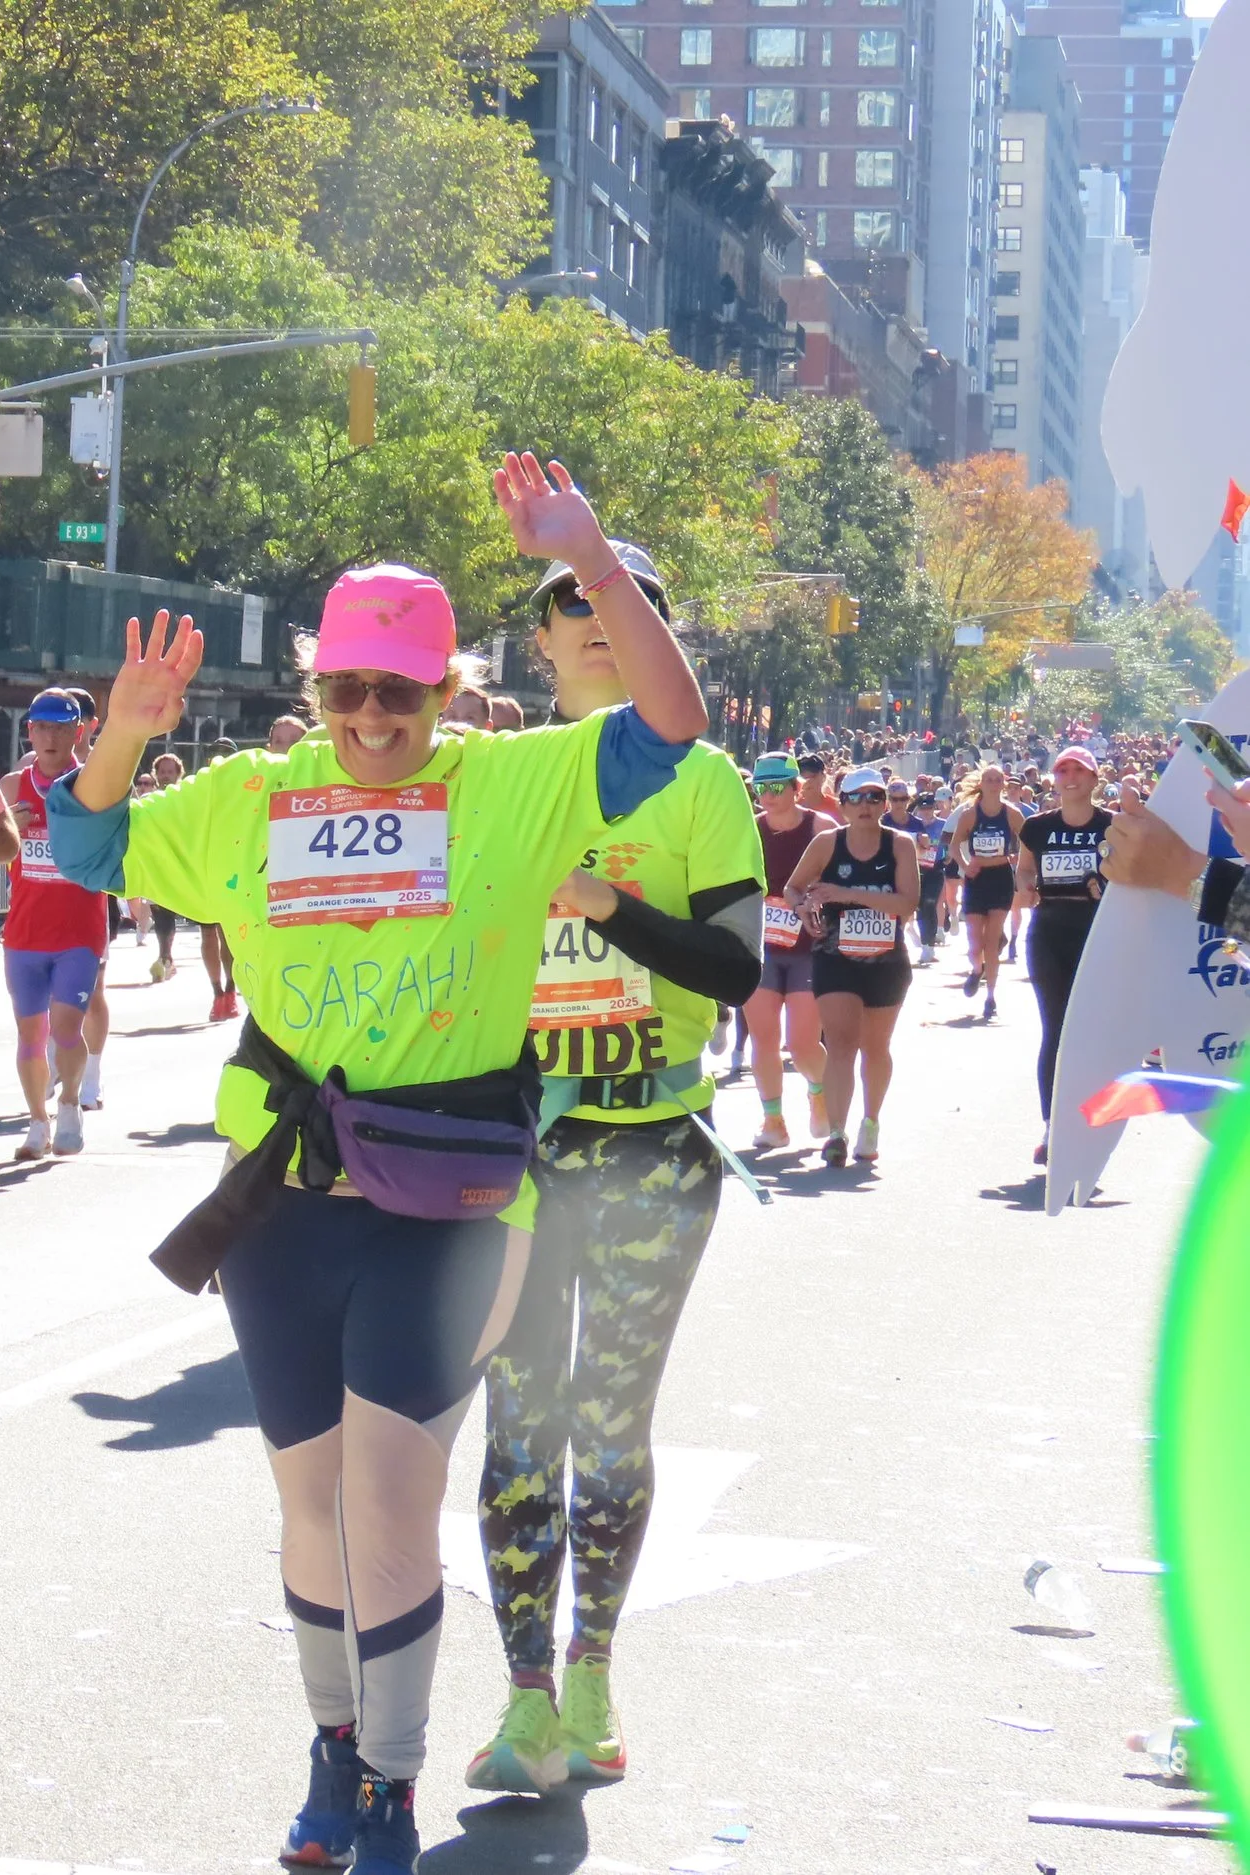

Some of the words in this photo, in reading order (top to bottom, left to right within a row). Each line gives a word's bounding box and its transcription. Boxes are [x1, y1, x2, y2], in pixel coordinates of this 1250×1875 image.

[66, 526, 72, 539] E
[76, 526, 88, 539] 93
[291, 796, 327, 813] tcs
[331, 793, 382, 804] CONSULTANCY
[331, 800, 364, 810] SERVICES
[396, 798, 424, 806] TATA
[308, 813, 403, 858] 428
[1047, 831, 1097, 845] ALEX
[1045, 855, 1093, 871] 37298
[420, 875, 444, 884] AWD
[270, 903, 292, 912] WAVE
[307, 899, 342, 907] ORANGE
[398, 891, 431, 902] 2025
[387, 907, 395, 916] B
[765, 908, 799, 926] 8219
[844, 920, 892, 936] 30108
[281, 940, 474, 1030] SARAH!
[532, 1006, 559, 1014] ORANGE
[561, 1005, 590, 1013] CORRAL
[610, 997, 639, 1009] 2025
[527, 1016, 668, 1075] UIDE
